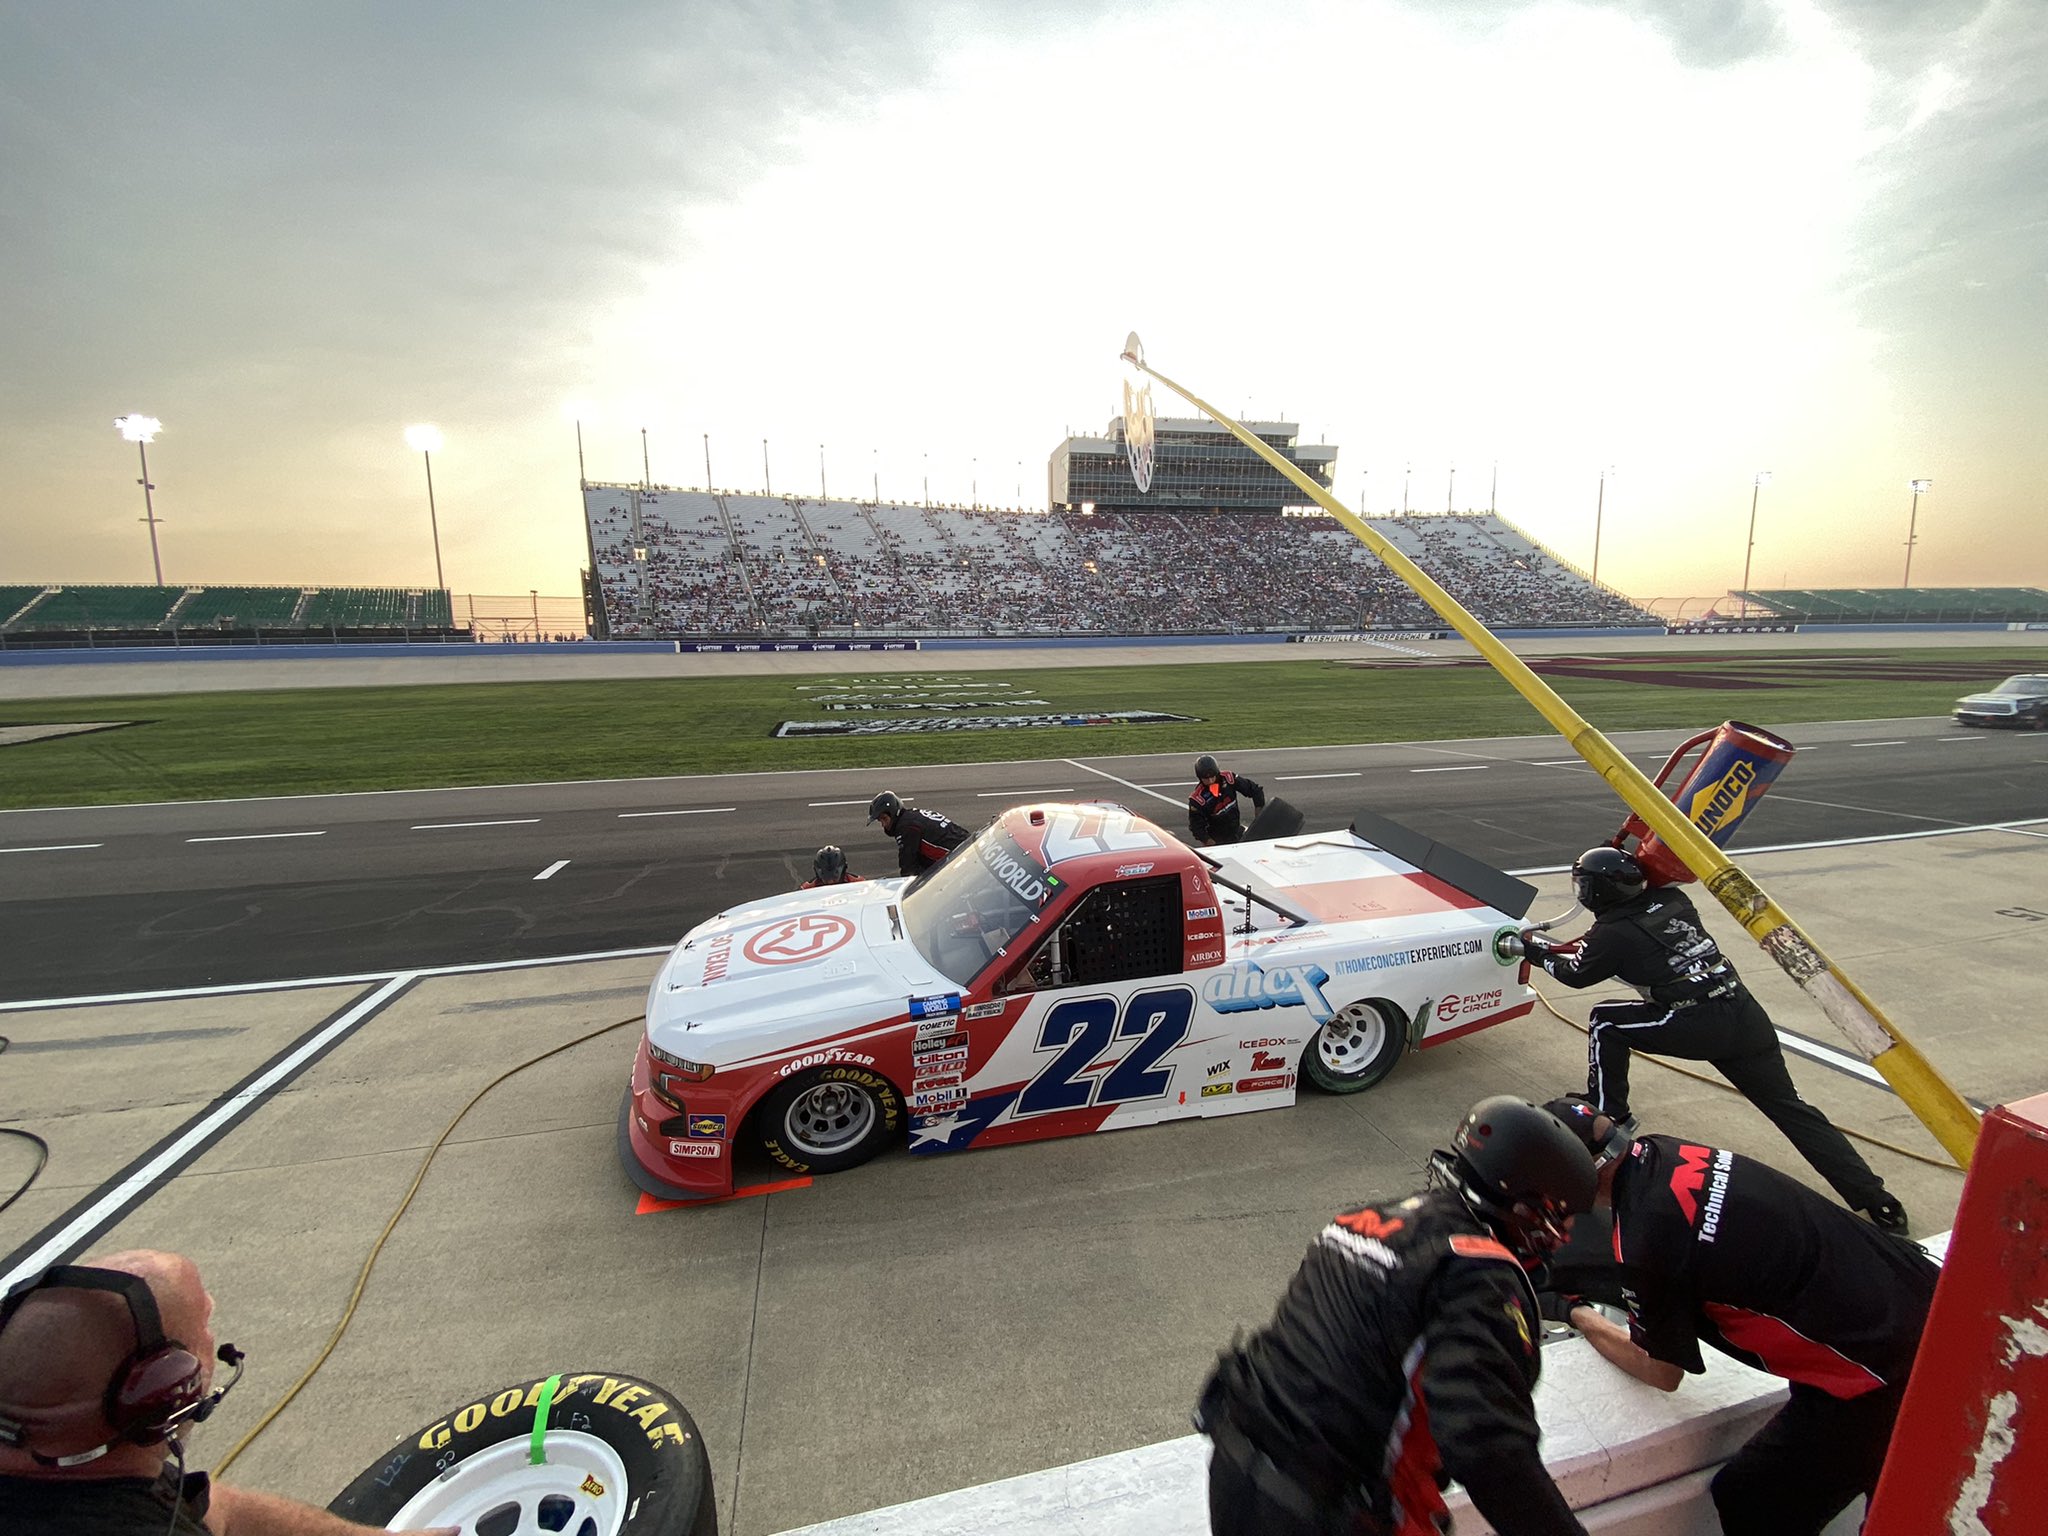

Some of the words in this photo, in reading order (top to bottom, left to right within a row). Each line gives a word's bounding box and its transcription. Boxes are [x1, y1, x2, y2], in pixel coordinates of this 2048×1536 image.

[1695, 762, 1753, 836] UNOCO
[990, 850, 1043, 901] WORLD
[1188, 908, 1208, 918] Mobil
[1190, 950, 1222, 962] AIRBOX
[1335, 939, 1483, 976] ATHOMECONCERTEXPERIENCE.COM
[1463, 989, 1503, 1005] FLYING
[1462, 1000, 1501, 1014] CIRCLE
[919, 1019, 956, 1032] COMETIC
[913, 1038, 946, 1052] Holley
[1010, 983, 1198, 1120] 22
[779, 1047, 876, 1077] GOODYEAR
[917, 1051, 966, 1065] tilton
[1206, 1060, 1231, 1077] WIX
[822, 1068, 898, 1131] GOODYEAR
[916, 1090, 952, 1105] Mobil
[916, 1100, 966, 1116] ARP
[692, 1123, 723, 1131] SUNOCO
[673, 1143, 716, 1156] SIMPSON
[764, 1139, 810, 1173] EAGLE
[1698, 1169, 1730, 1243] Technical
[582, 1480, 603, 1495] AERO
